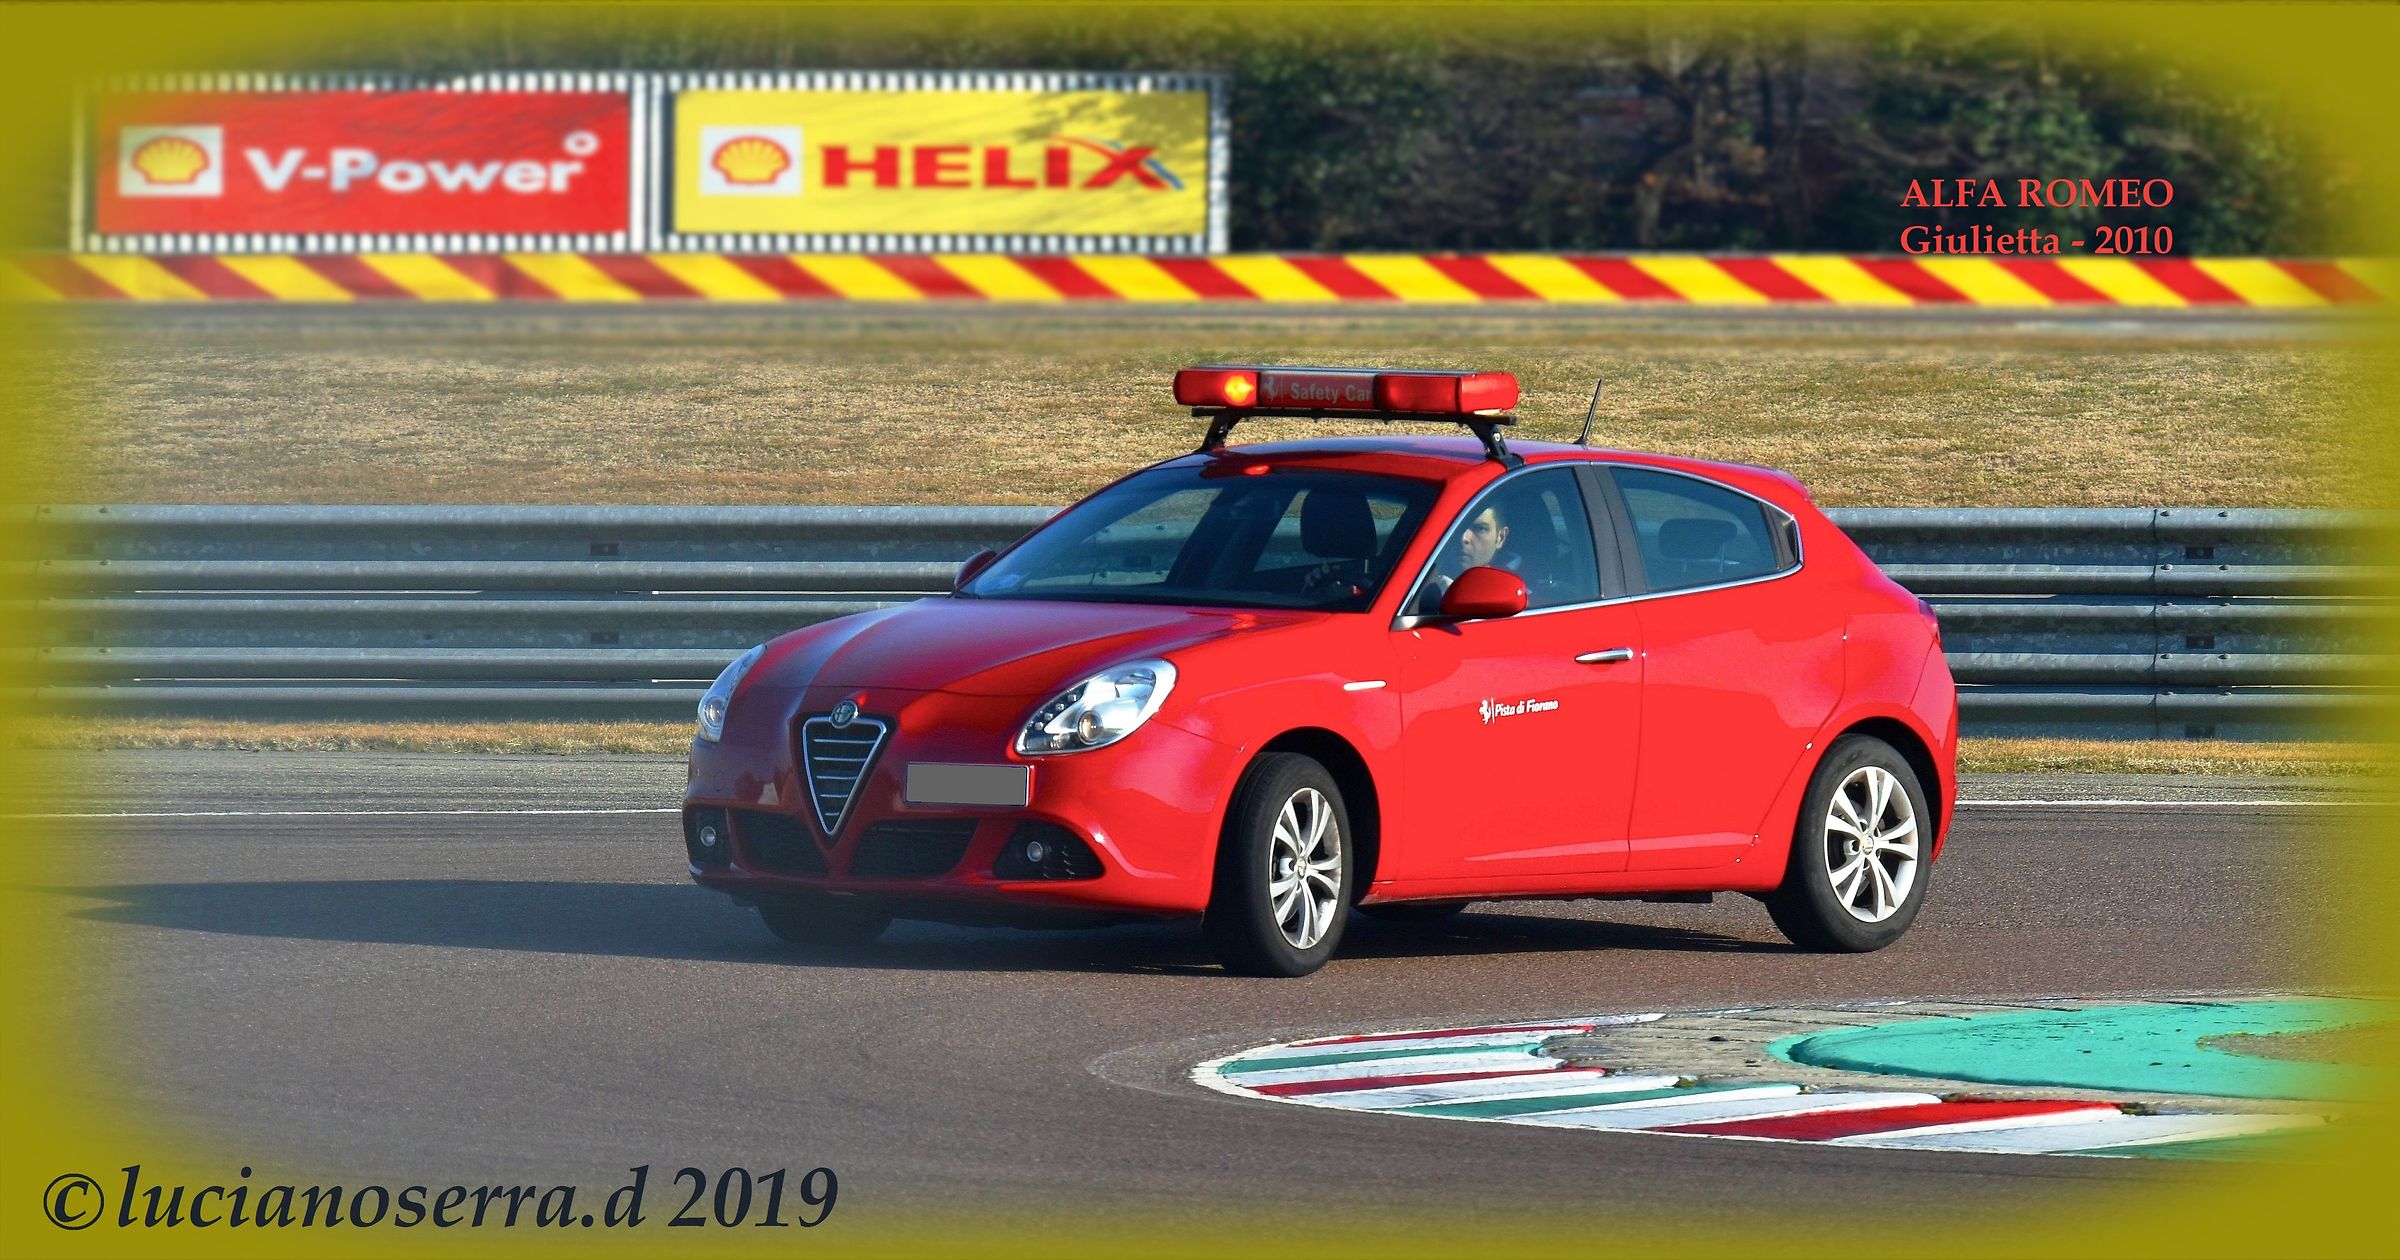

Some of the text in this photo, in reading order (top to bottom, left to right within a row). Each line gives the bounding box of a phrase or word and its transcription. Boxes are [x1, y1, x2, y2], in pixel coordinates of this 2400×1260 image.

[245, 146, 585, 192] V-Power
[819, 136, 1184, 190] HELIX
[1291, 382, 1339, 404] Safety
[1495, 699, 1558, 716] Pista di Fiorano
